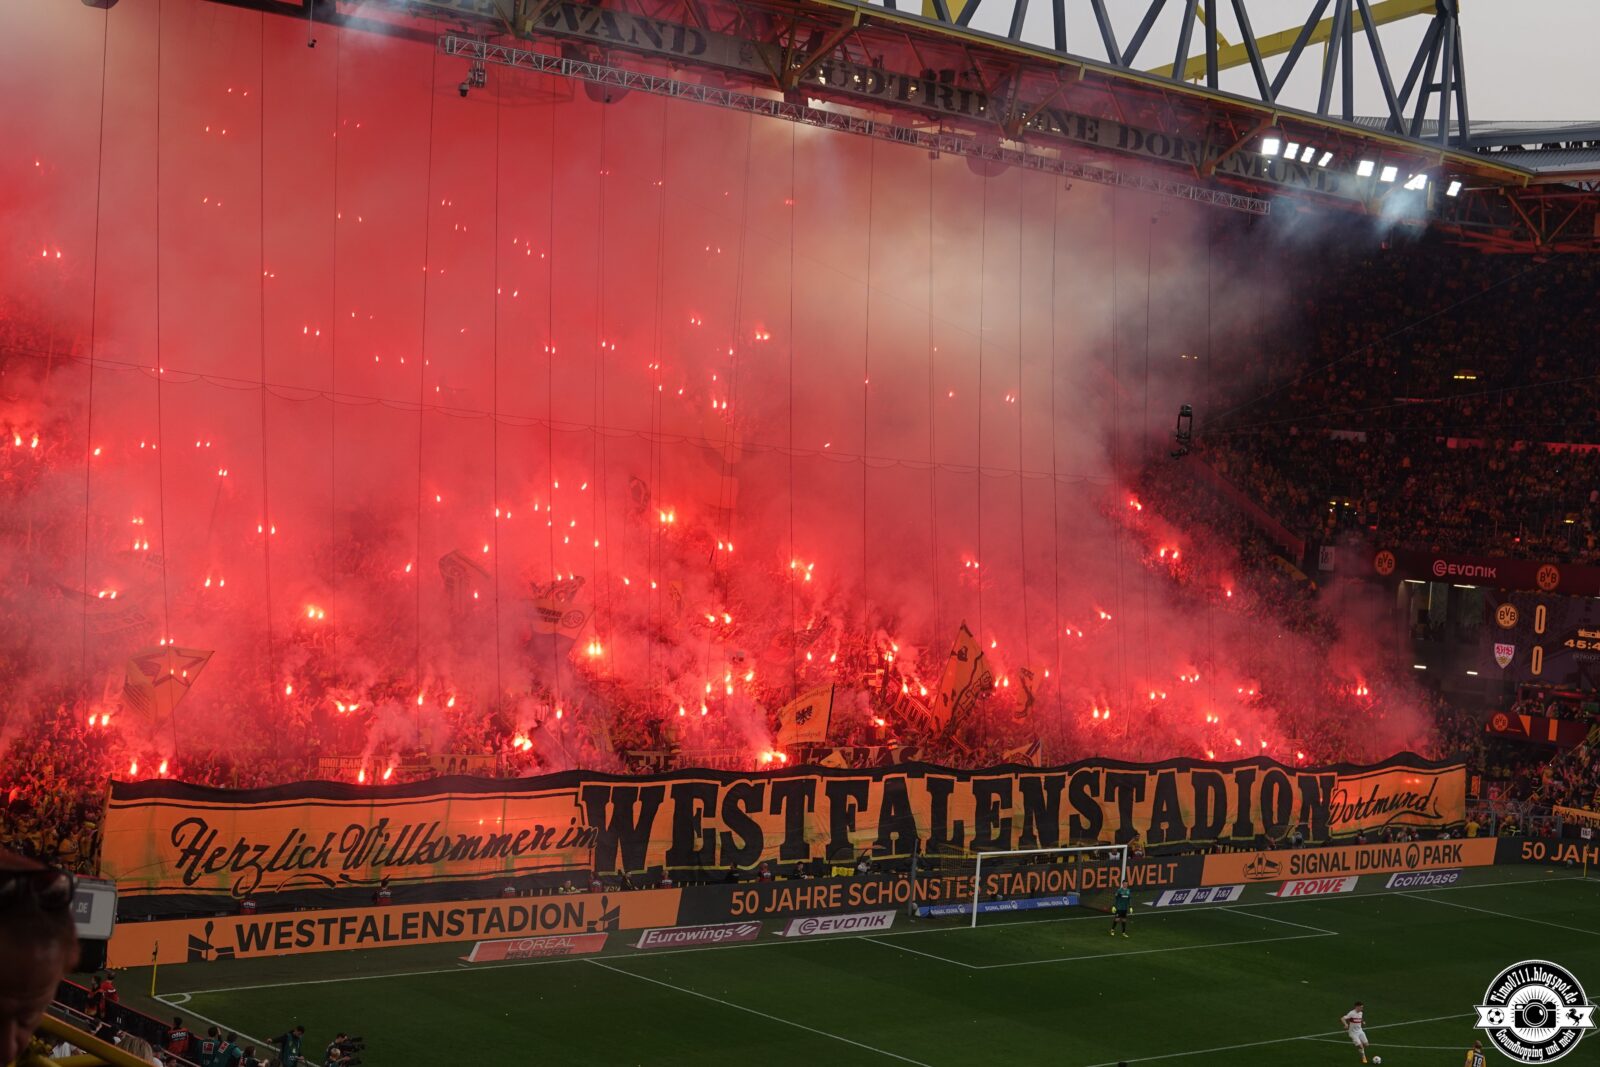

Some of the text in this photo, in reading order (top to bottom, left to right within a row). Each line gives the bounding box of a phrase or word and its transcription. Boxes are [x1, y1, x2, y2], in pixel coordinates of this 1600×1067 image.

[1535, 605, 1546, 634] 0
[1532, 645, 1543, 675] 0
[171, 768, 1438, 897] Herzlich Willkommen im WESTFALENSTADION Dortmund
[1290, 843, 1463, 876] SIGNAL IDUNA PARK
[1521, 841, 1546, 861] 50
[730, 862, 1178, 917] 50 JAHRE SCHÖNSTES STADION DER WELT
[1292, 877, 1346, 896] ROWE
[1393, 870, 1460, 889] coinbase
[234, 900, 585, 954] WESTFALENSTADION
[645, 925, 734, 945] Eurowings
[816, 913, 886, 934] EVONIK
